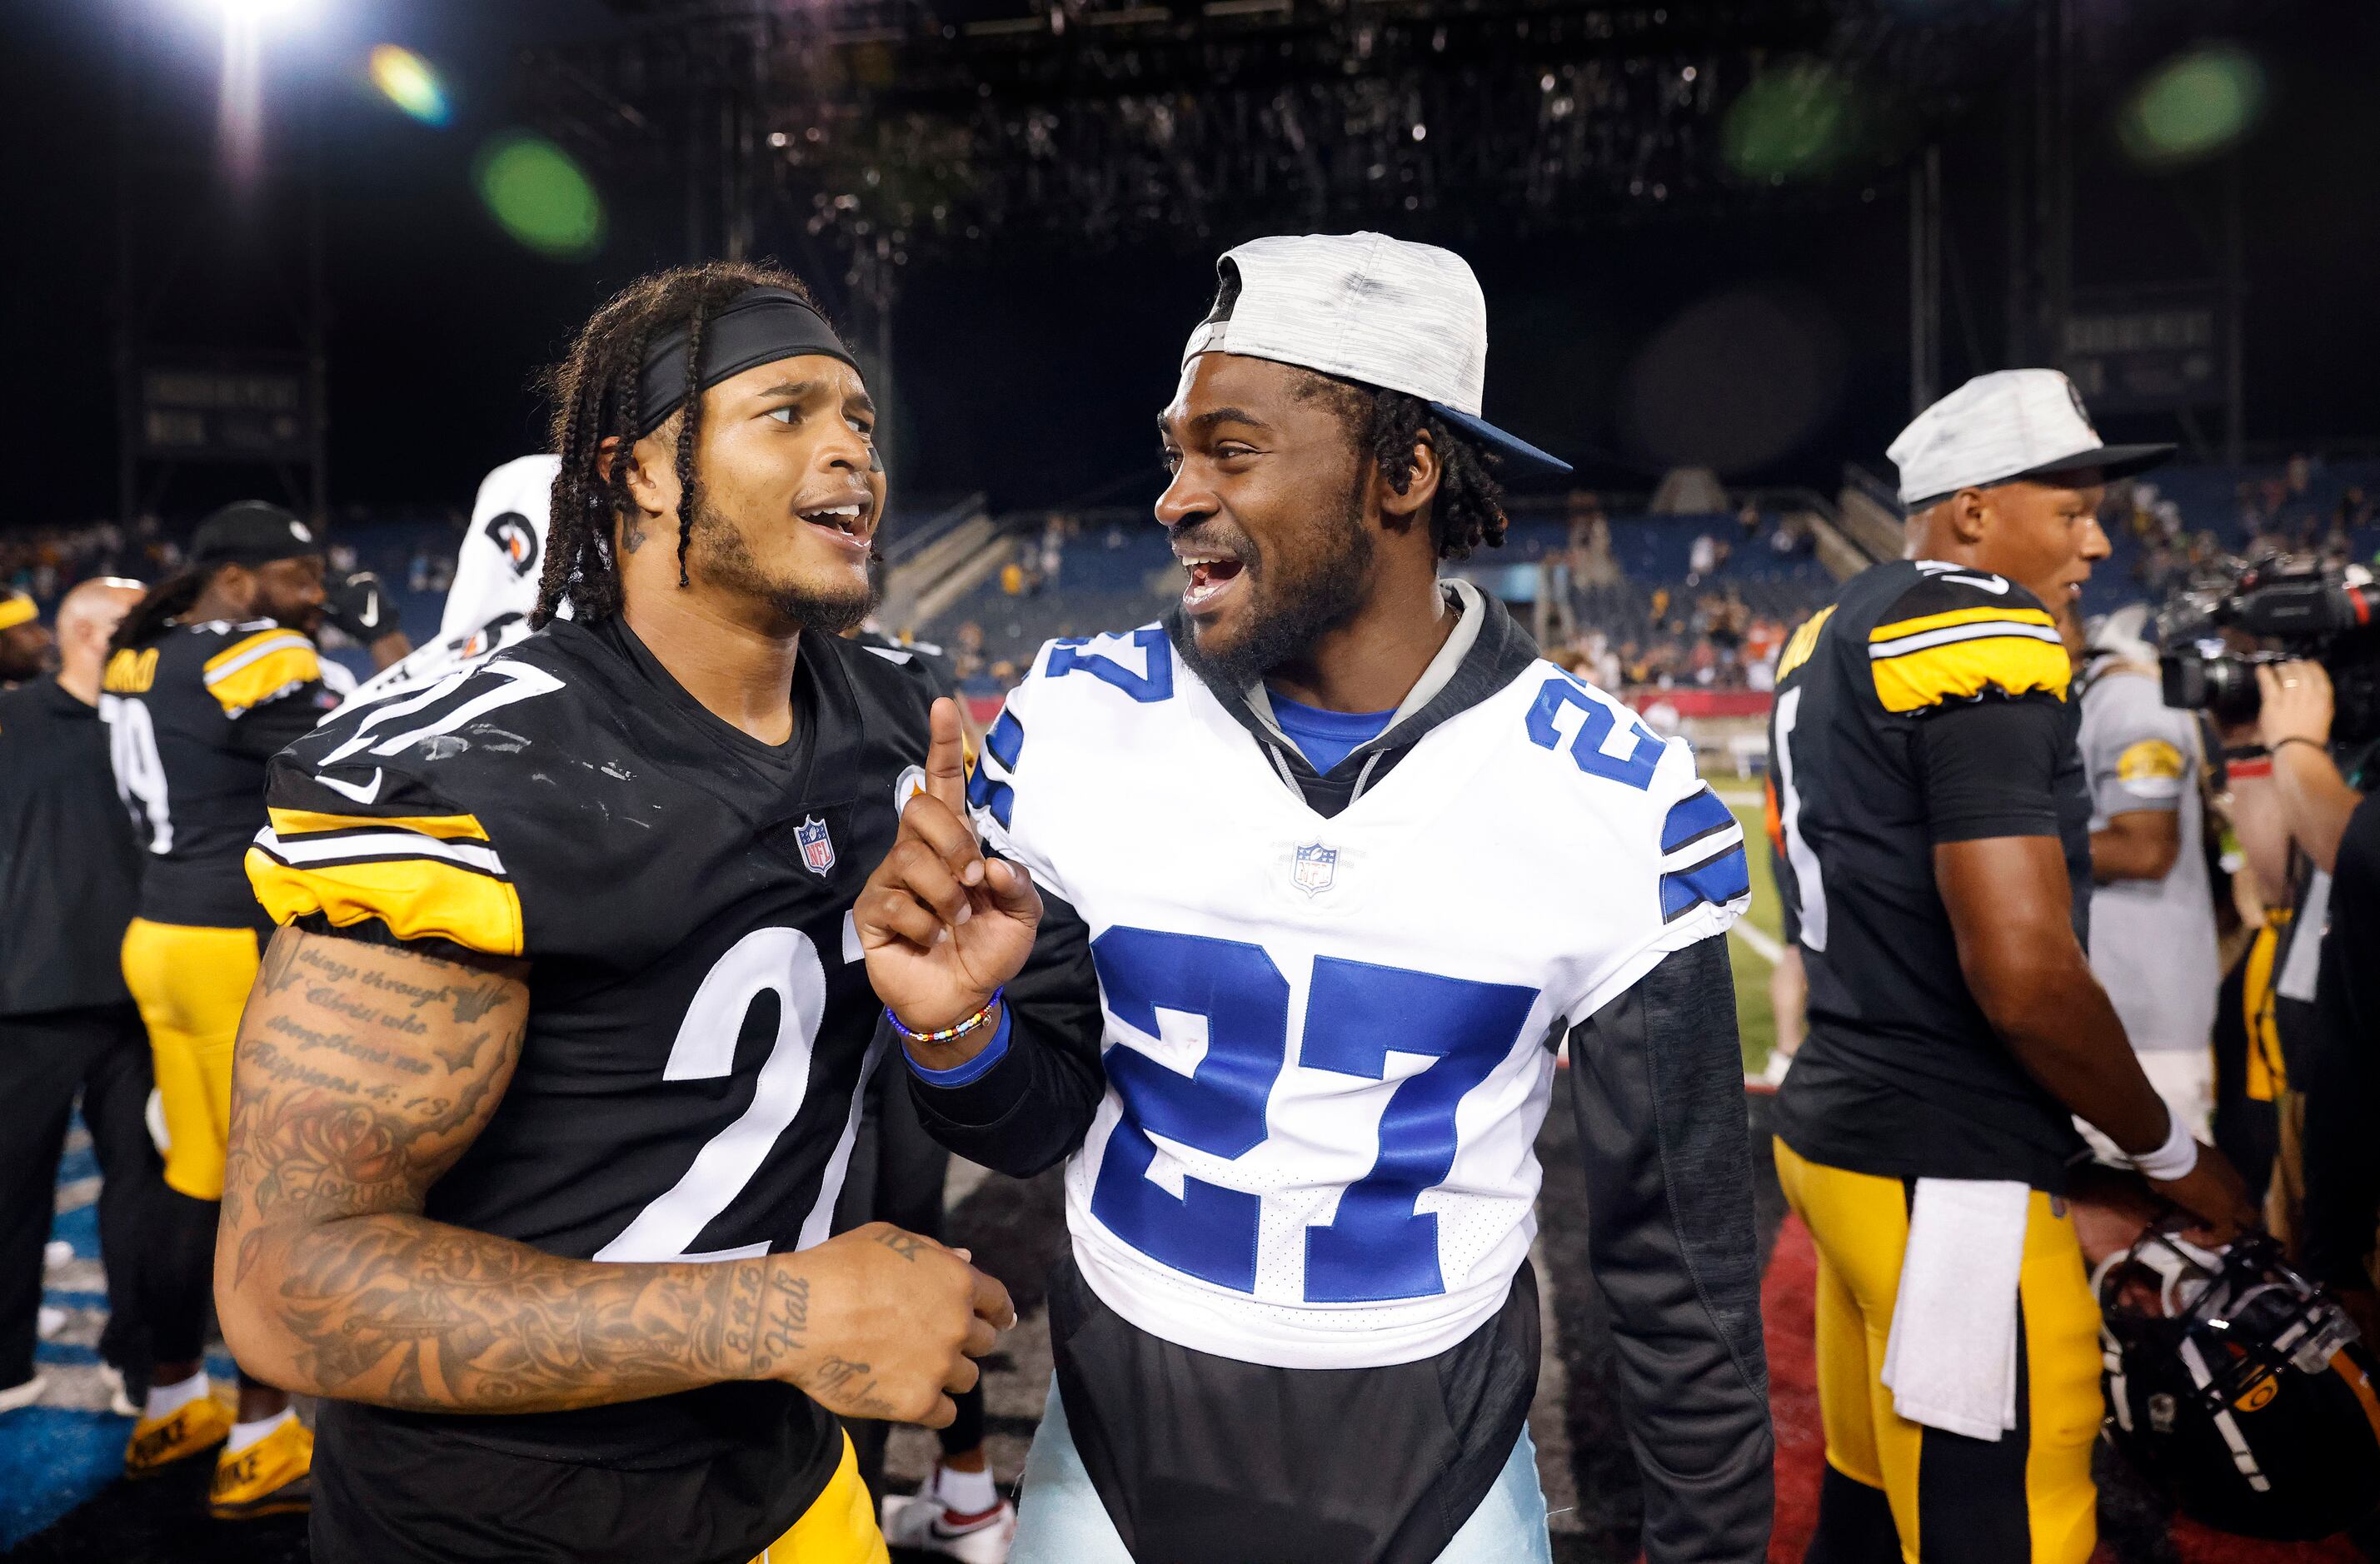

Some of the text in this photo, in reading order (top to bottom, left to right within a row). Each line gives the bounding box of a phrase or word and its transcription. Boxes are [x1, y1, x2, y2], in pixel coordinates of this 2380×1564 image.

[1045, 629, 1175, 704] 7
[1524, 663, 1667, 792] 2
[806, 840, 831, 867] NFL
[1297, 860, 1330, 886] NFL
[361, 970, 451, 1009] through
[381, 1014, 427, 1035] who
[1090, 924, 1541, 1303] 27
